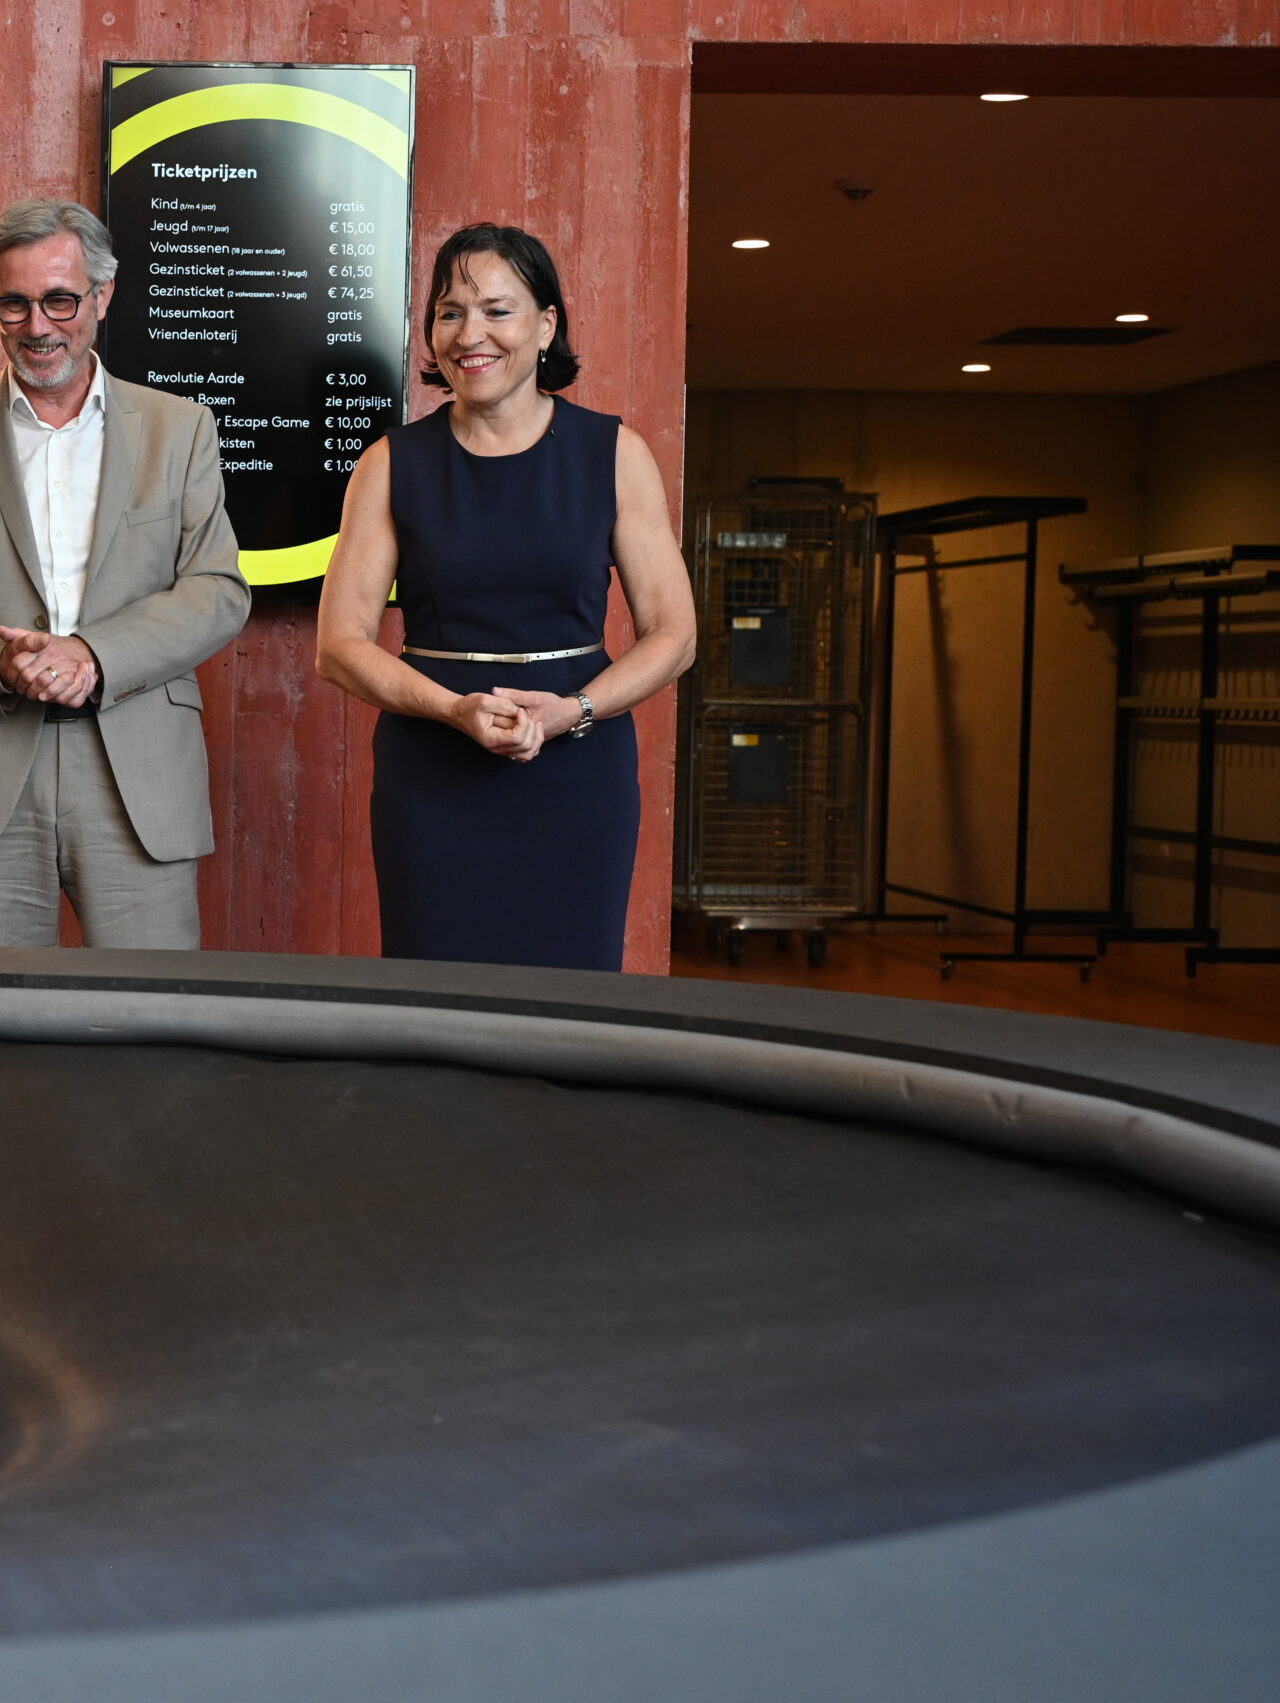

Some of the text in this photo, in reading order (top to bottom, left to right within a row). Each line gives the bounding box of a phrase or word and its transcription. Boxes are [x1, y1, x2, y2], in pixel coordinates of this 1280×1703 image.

[152, 163, 257, 182] Ticketprijzen
[152, 198, 178, 209] Kind
[180, 203, 194, 211] (t/m
[330, 200, 365, 215] gratis
[151, 220, 188, 234] Jeugd
[207, 225, 215, 233] 17
[330, 222, 338, 233] €
[343, 222, 374, 235] 15,00
[150, 242, 229, 253] Volwassenen
[329, 244, 338, 254] €
[342, 243, 375, 258] 18,00
[150, 263, 224, 275] Gezinsticket
[287, 270, 307, 278] jeugd)
[329, 265, 337, 276] €
[341, 264, 373, 280] 61,50
[149, 285, 224, 297] Gezinsticket
[328, 287, 337, 298] €
[341, 286, 375, 301] 74,25
[150, 307, 362, 323] Museumkaart gratis
[148, 328, 361, 345] Vriendenloterij gratis
[148, 371, 366, 386] Revolutie Aarde € 3,00
[197, 394, 236, 406] Boxen
[326, 396, 342, 406] zie
[346, 396, 391, 410] prijslijst
[225, 416, 268, 430] Escape
[272, 416, 309, 427] Game
[325, 417, 334, 428] €
[338, 417, 370, 429] 10,00
[325, 438, 333, 449] €
[337, 439, 361, 451] 1,00
[324, 460, 333, 471] €
